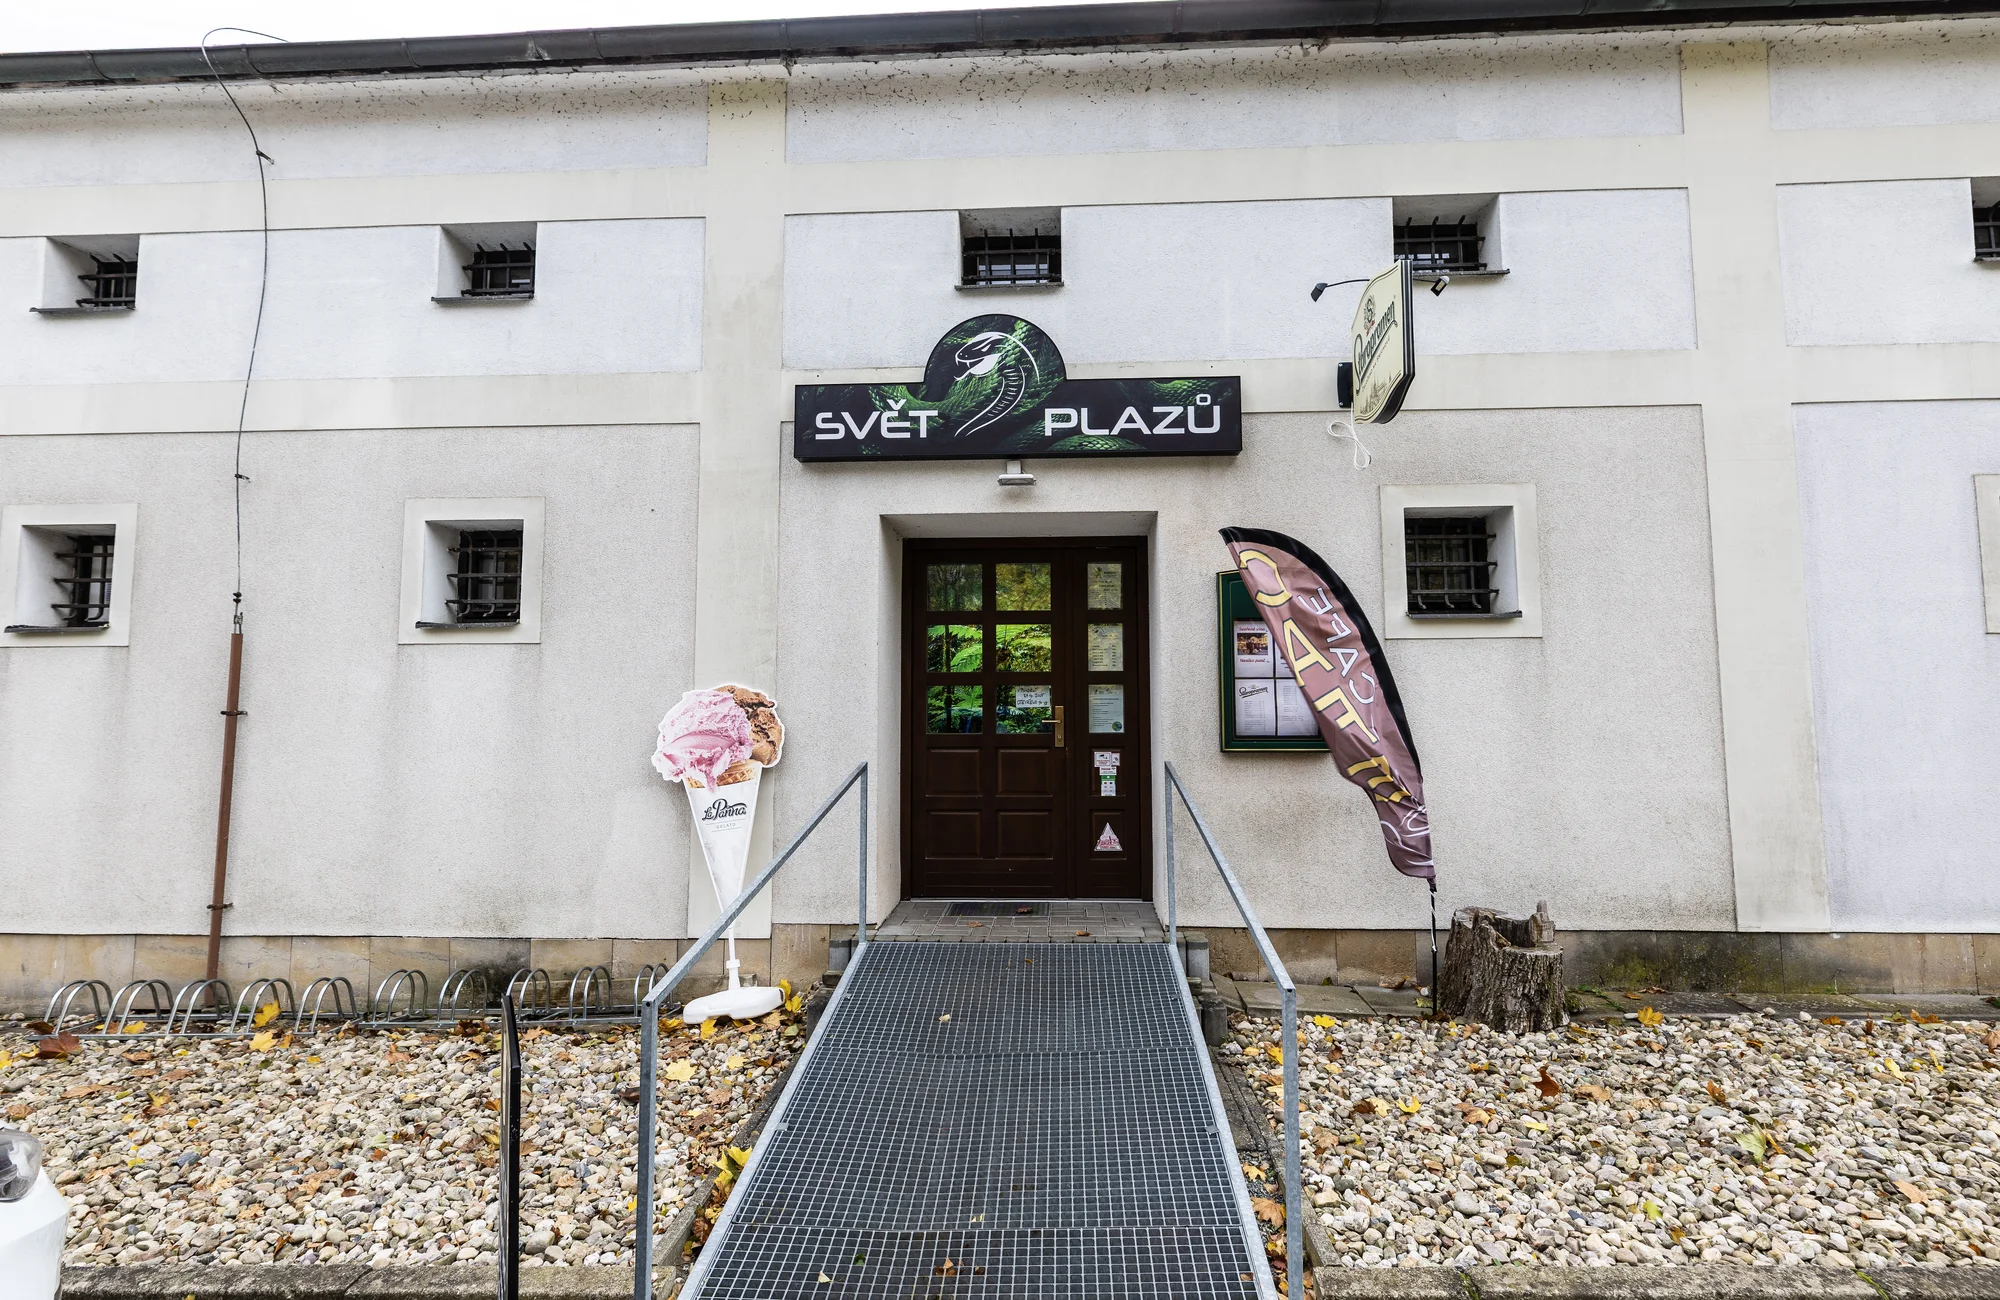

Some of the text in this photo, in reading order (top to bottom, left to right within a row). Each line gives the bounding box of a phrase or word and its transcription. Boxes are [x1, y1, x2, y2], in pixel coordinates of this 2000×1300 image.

[1354, 300, 1398, 397] Staropramen
[815, 393, 1220, 440] SVĚT PLAZŮ
[702, 798, 747, 820] La Panna
